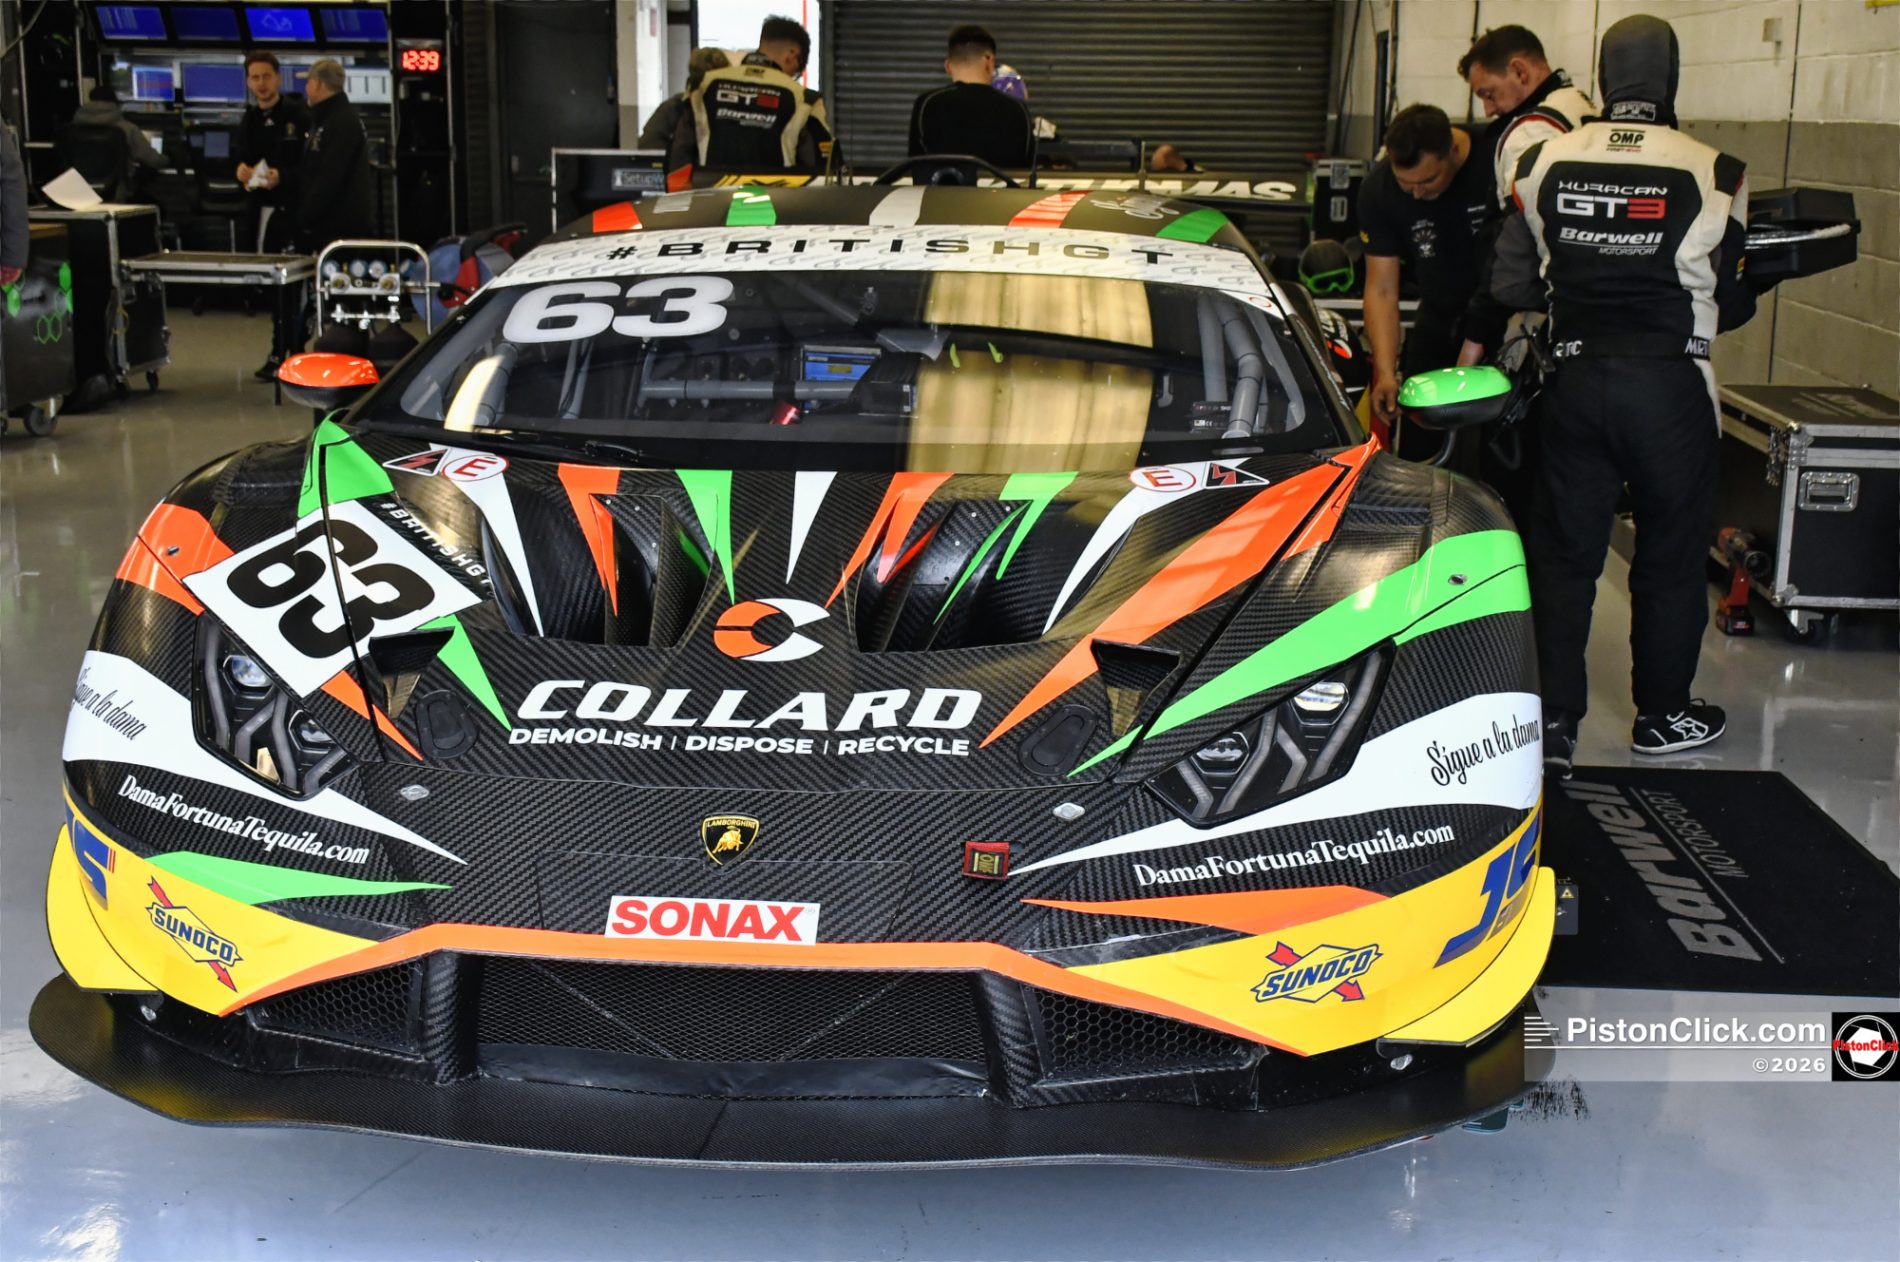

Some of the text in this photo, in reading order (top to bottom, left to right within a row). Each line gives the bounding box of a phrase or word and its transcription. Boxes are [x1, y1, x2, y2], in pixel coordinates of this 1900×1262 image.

[403, 50, 440, 71] 12:39
[1609, 132, 1645, 145] OMP
[1556, 192, 1666, 219] GT3
[1558, 180, 1668, 195] HURACAN
[1559, 226, 1664, 244] Barwell
[1598, 246, 1659, 256] MOTORSPORT
[503, 276, 735, 343] 63
[453, 458, 498, 477] E
[1142, 470, 1183, 487] E
[227, 519, 435, 658] 63
[517, 679, 982, 732] COLLARD
[508, 728, 970, 756] DEMOLISH DISPOSE RECYCLE
[1426, 740, 1484, 786] Sigue
[1482, 737, 1497, 759] a
[1492, 720, 1514, 754] la
[118, 774, 370, 864] DamaFortunaTequila.com
[706, 819, 756, 829] LAMBORGHINI
[1641, 788, 1750, 879] MOTORSPORT
[1133, 824, 1456, 886] DamaFortunaTequila.com
[1559, 780, 1764, 962] Barwell
[154, 908, 234, 962] SUNOCO
[611, 899, 805, 942] SONAX
[1261, 949, 1374, 997] SUNOCO
